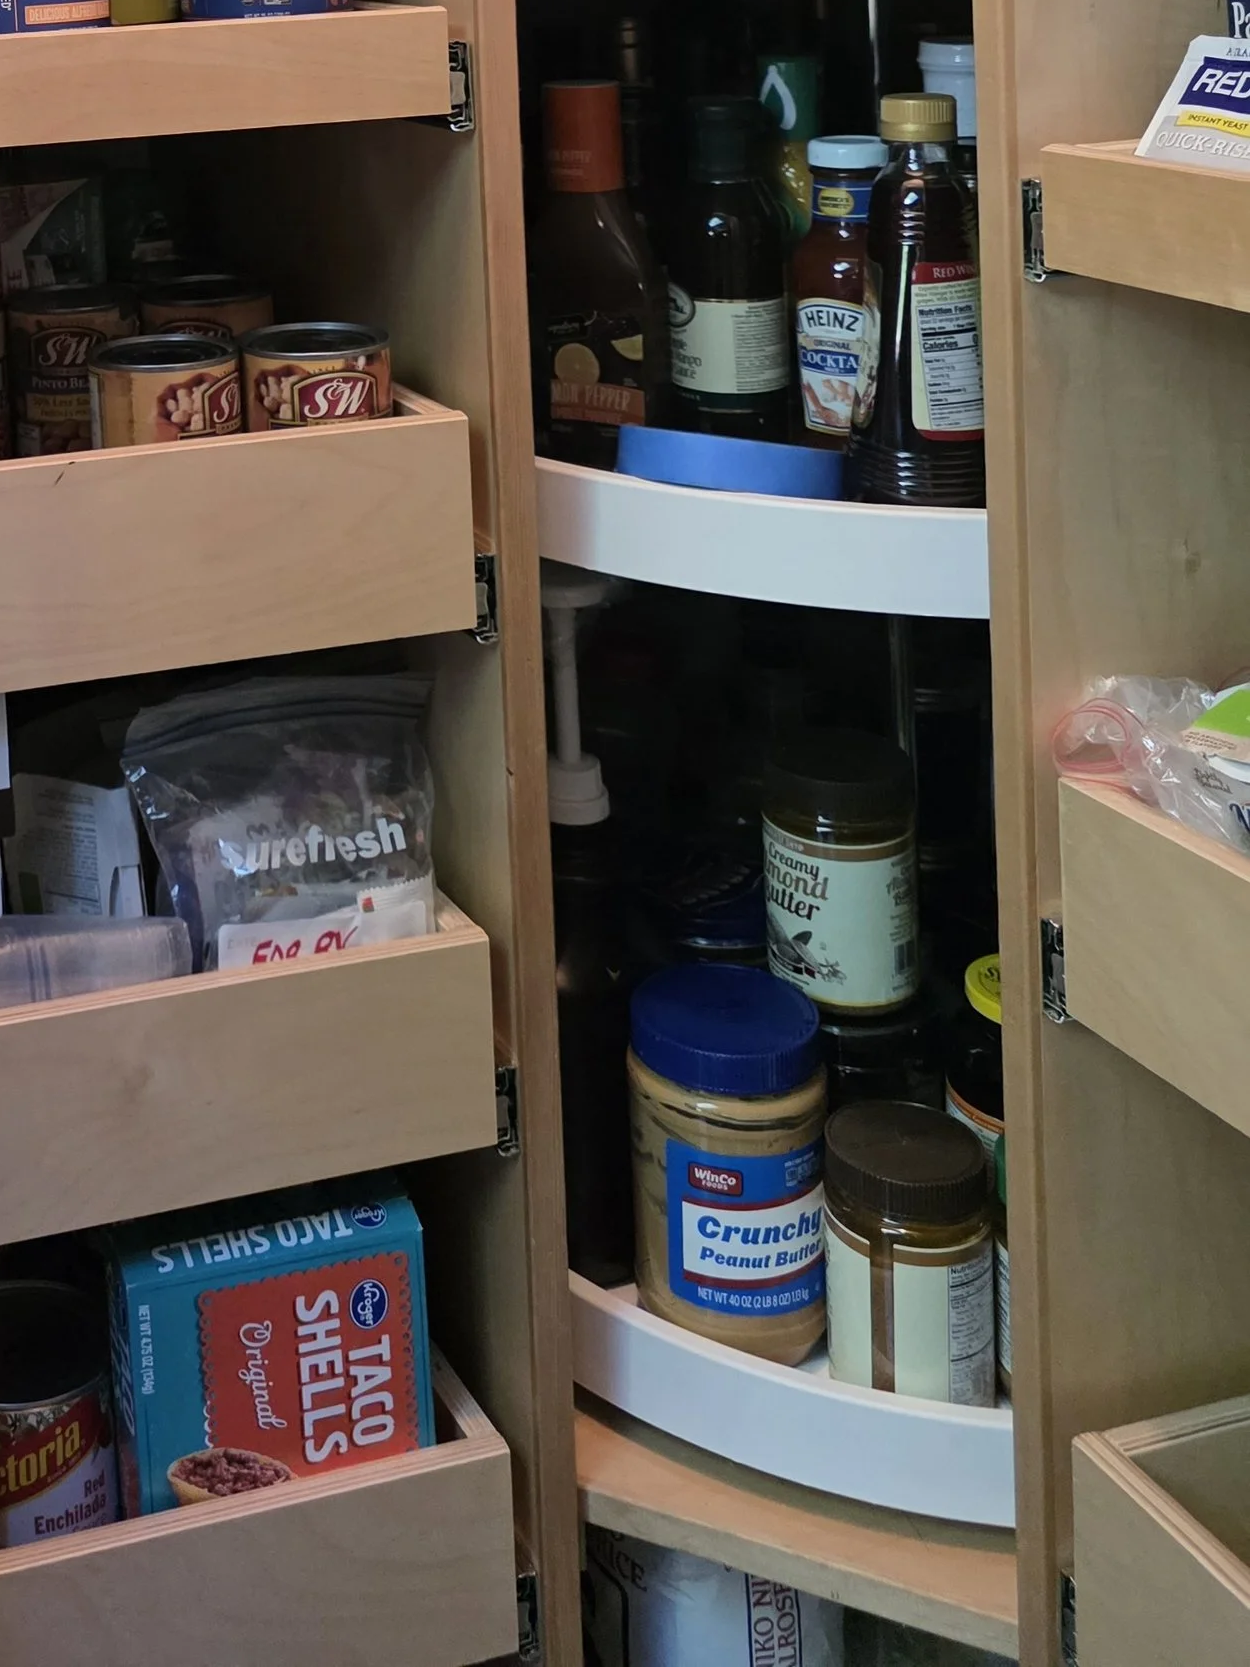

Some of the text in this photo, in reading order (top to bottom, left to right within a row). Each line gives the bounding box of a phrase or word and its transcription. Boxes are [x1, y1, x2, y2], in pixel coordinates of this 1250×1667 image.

[1192, 69, 1250, 99] RED
[1187, 113, 1249, 131] INSTANT YEAST
[933, 266, 955, 279] RED
[804, 309, 860, 333] HEINZ
[918, 304, 973, 317] Nutrition Facts
[922, 339, 959, 351] Calories
[800, 350, 861, 372] COCKTA
[303, 375, 374, 419] S&W
[583, 384, 631, 412] PEPPER
[768, 841, 820, 881] Creamy
[693, 1167, 737, 1187] WinCo
[696, 1205, 822, 1246] Crunchy
[151, 1208, 353, 1274] TACO SHELLS
[699, 1237, 822, 1270] Peanut Butter
[359, 1281, 384, 1327] Kroger
[697, 1286, 713, 1302] NET
[713, 1290, 729, 1306] WT
[729, 1294, 741, 1307] 40
[741, 1296, 752, 1308] OZ
[762, 1296, 772, 1309] LB
[138, 1304, 150, 1321] NET
[139, 1321, 152, 1337] WT
[141, 1355, 154, 1368] OZ
[239, 1319, 288, 1430] Original
[295, 1289, 349, 1465] SHELLS
[348, 1334, 396, 1446] TACO
[83, 1469, 106, 1497] Red
[33, 1492, 107, 1536] Enchilada
